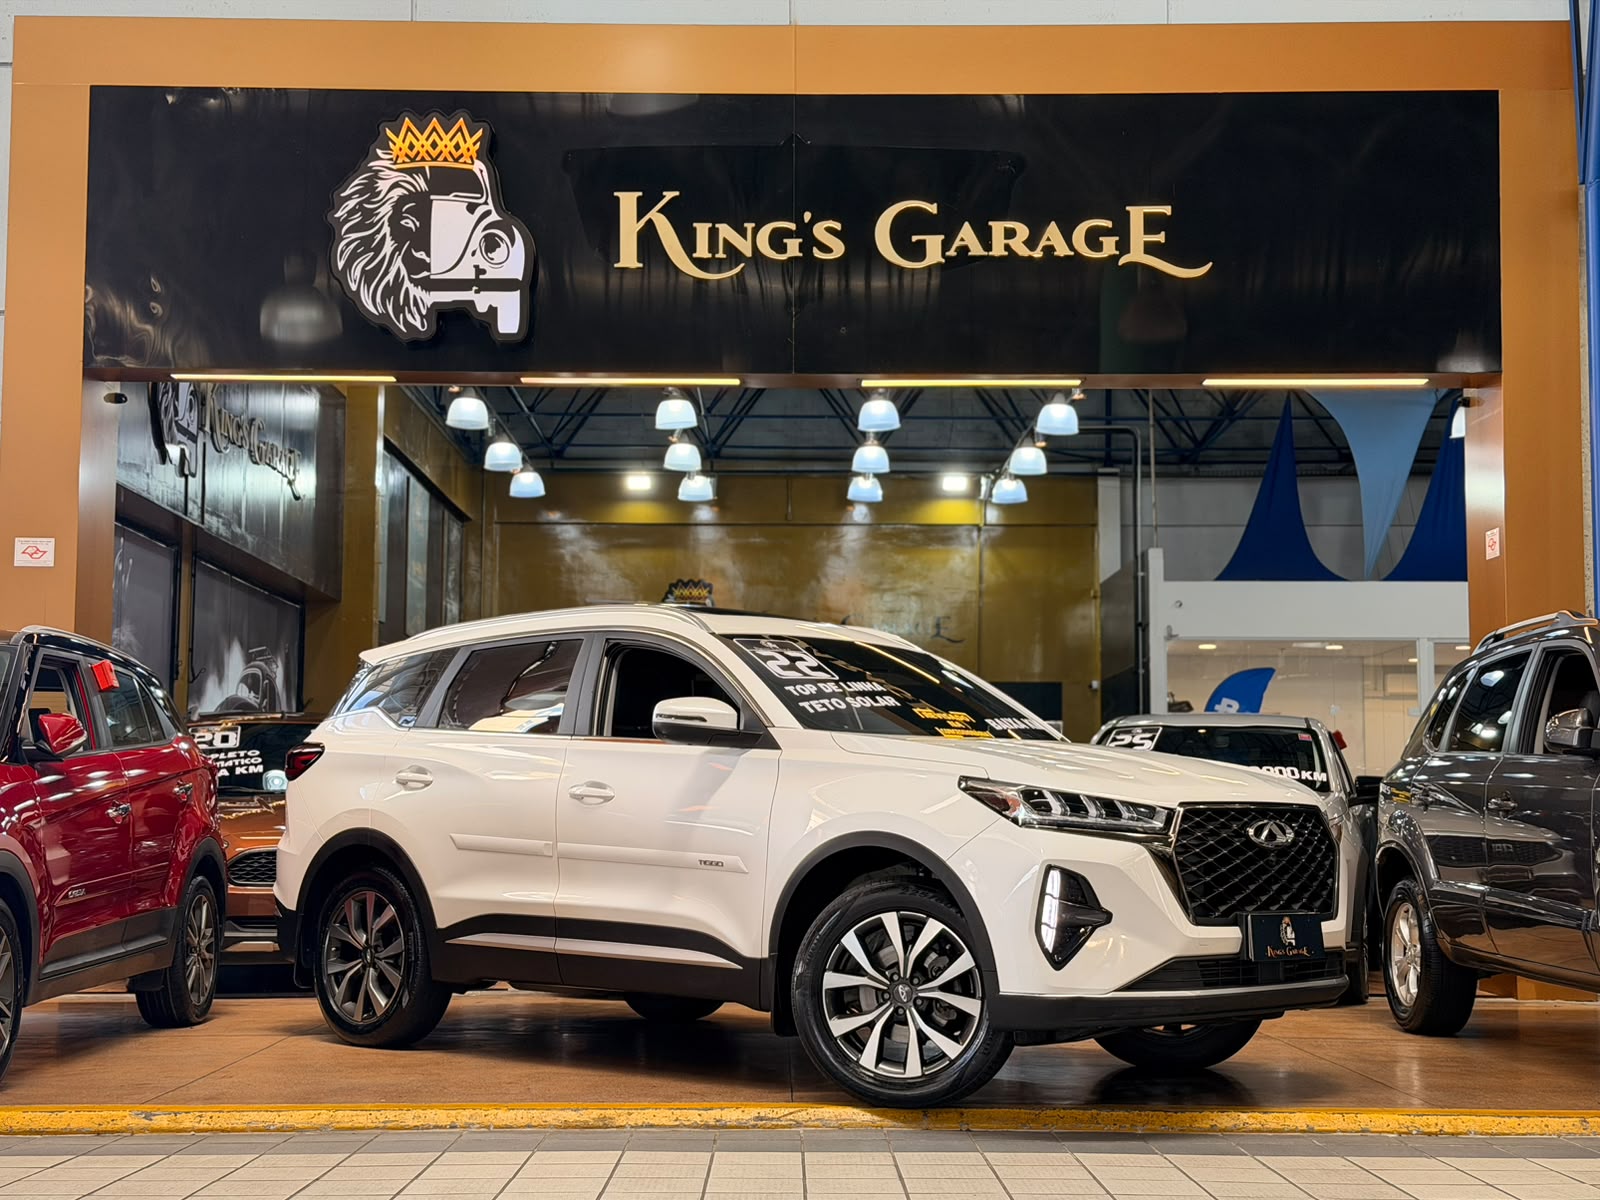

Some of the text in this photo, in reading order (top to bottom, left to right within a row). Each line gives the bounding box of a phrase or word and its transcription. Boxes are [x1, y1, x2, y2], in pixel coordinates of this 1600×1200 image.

[613, 191, 1213, 279] KING'S GARAGE
[755, 650, 834, 679] 22
[784, 681, 887, 697] TOP DE LINHA
[798, 695, 901, 714] TETO SOLAR
[193, 731, 238, 749] 20
[1109, 733, 1153, 751] 25
[209, 749, 260, 760] PLETO
[235, 764, 264, 775] KM
[1301, 770, 1327, 782] KM
